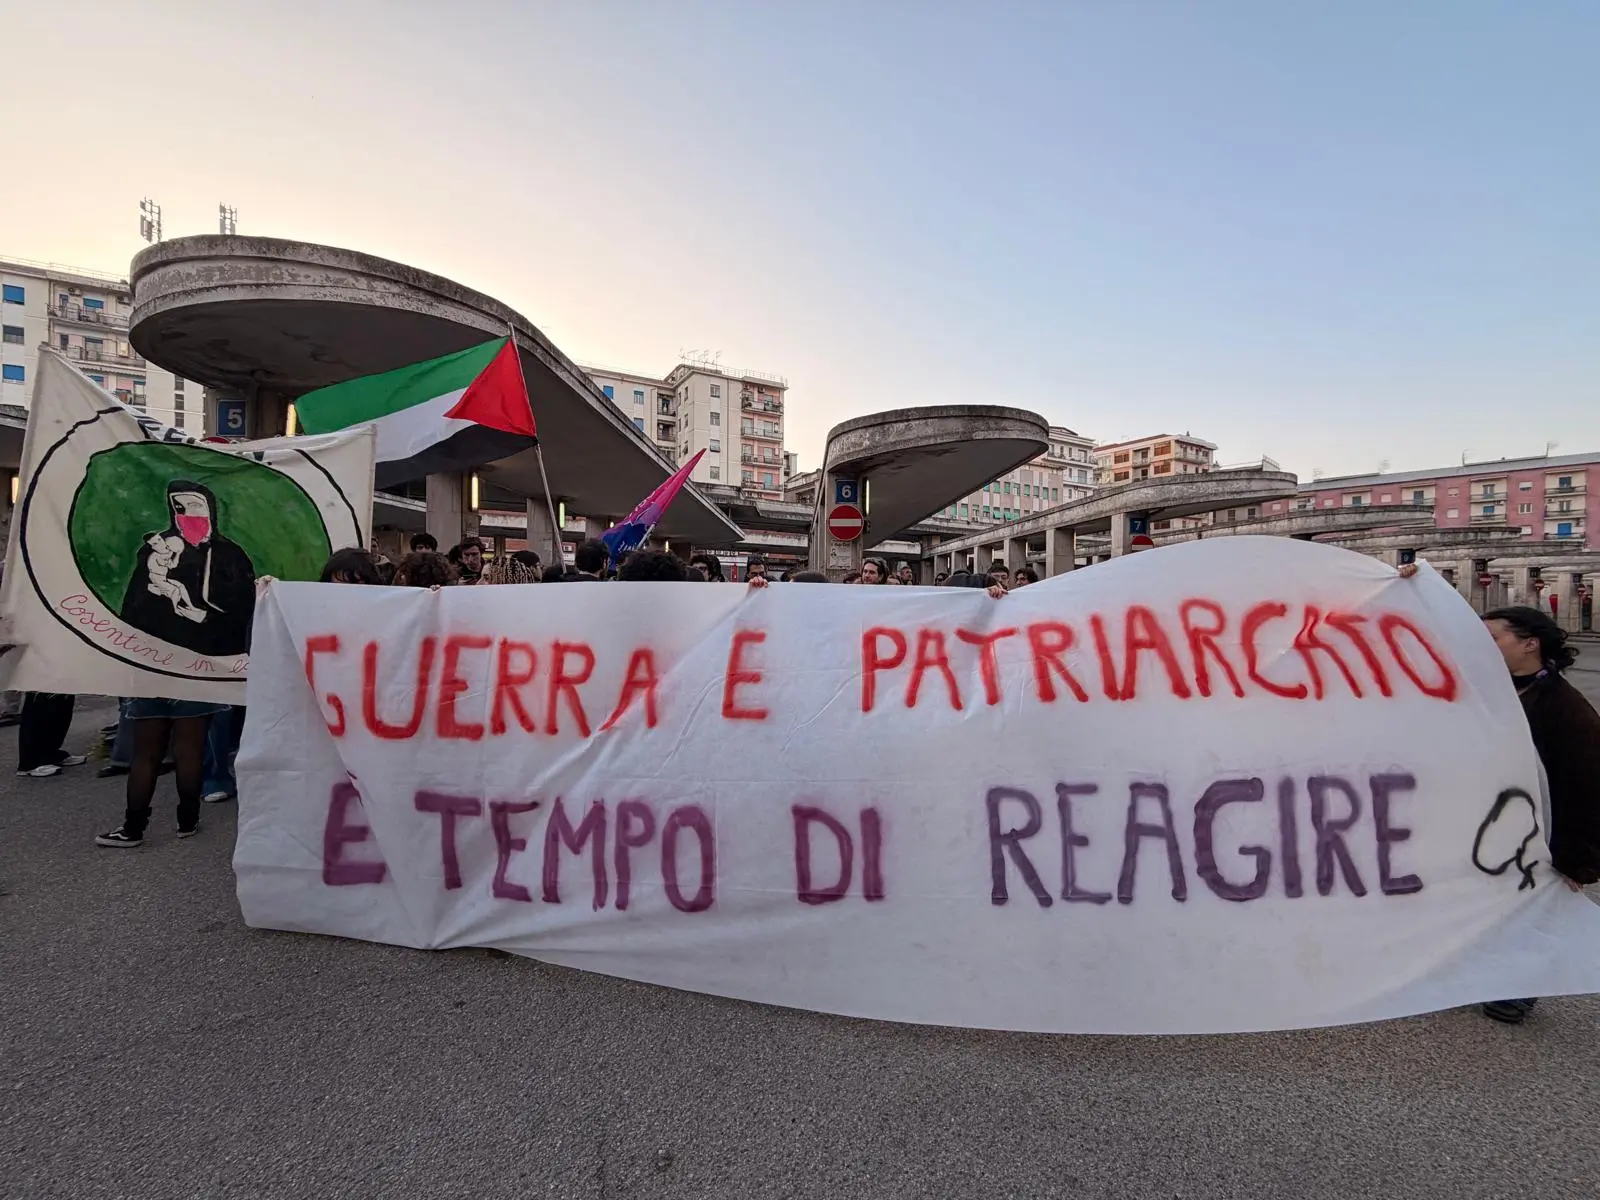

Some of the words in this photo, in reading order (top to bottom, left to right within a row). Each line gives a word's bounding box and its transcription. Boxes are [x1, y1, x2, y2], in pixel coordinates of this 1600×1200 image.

[227, 408, 243, 429] 5
[841, 484, 852, 498] 6
[1133, 520, 1142, 531] 7
[60, 594, 174, 666] Cosentine
[185, 658, 216, 673] in
[304, 633, 658, 741] GUERRA
[721, 630, 768, 720] E
[861, 597, 1457, 712] PATRIARCATO
[414, 789, 716, 914] TEMPO
[792, 804, 886, 905] DI
[986, 773, 1424, 908] REAGIRE
